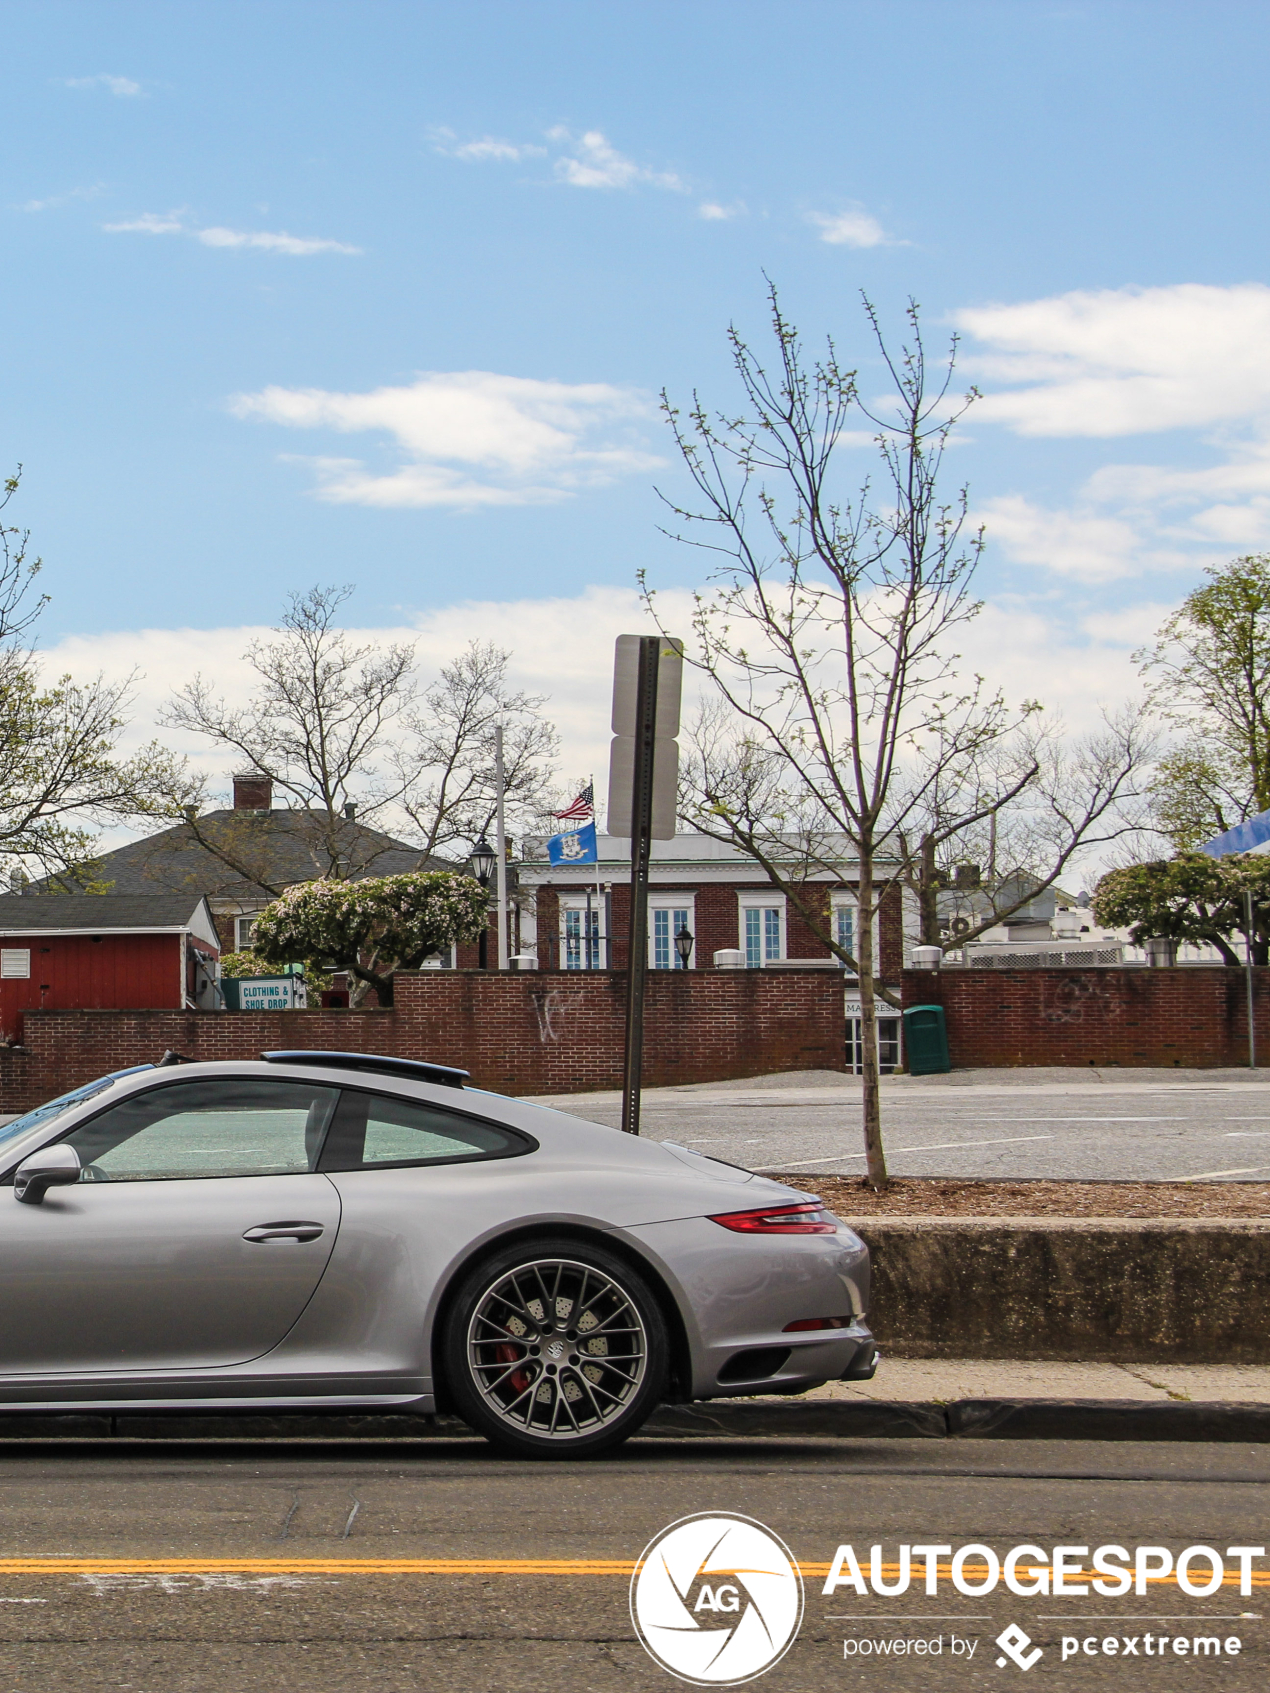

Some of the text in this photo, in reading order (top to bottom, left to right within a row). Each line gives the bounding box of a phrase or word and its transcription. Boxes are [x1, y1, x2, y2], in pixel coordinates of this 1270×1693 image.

[244, 986, 288, 997] CLOTHING &
[245, 999, 287, 1009] SHOE DROP
